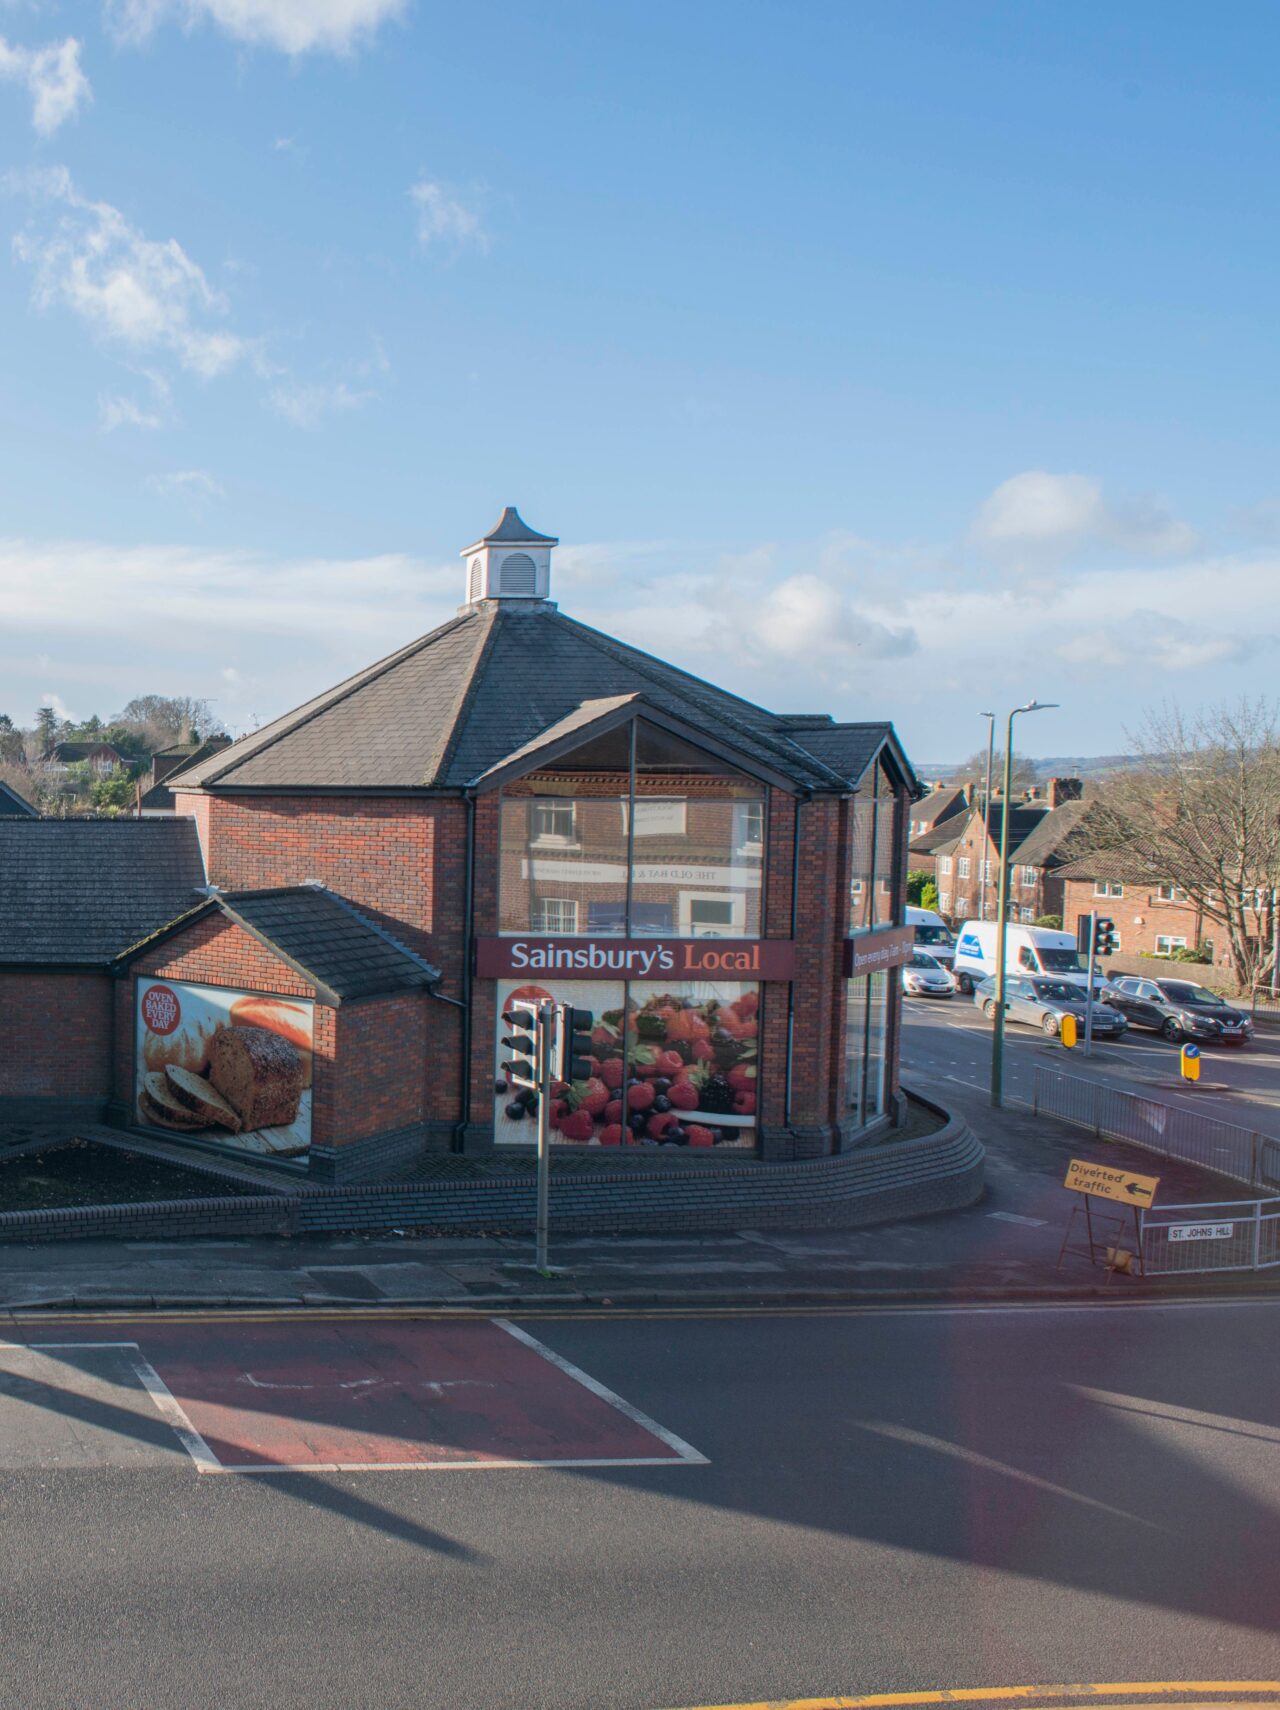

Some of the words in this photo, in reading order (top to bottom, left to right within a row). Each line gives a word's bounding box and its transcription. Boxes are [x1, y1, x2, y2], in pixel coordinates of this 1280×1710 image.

[511, 943, 674, 975] Sainsbury's
[683, 944, 761, 970] Local
[148, 991, 174, 1003] OVEN
[146, 1000, 177, 1013] BAKED
[146, 1008, 177, 1022] EVERY
[152, 1018, 169, 1029] DAY
[1071, 1163, 1125, 1183] Diverted
[1074, 1177, 1112, 1194] traffic
[1172, 1229, 1184, 1239] ST.
[1187, 1227, 1213, 1238] JOHNS
[1215, 1226, 1231, 1237] HILL
